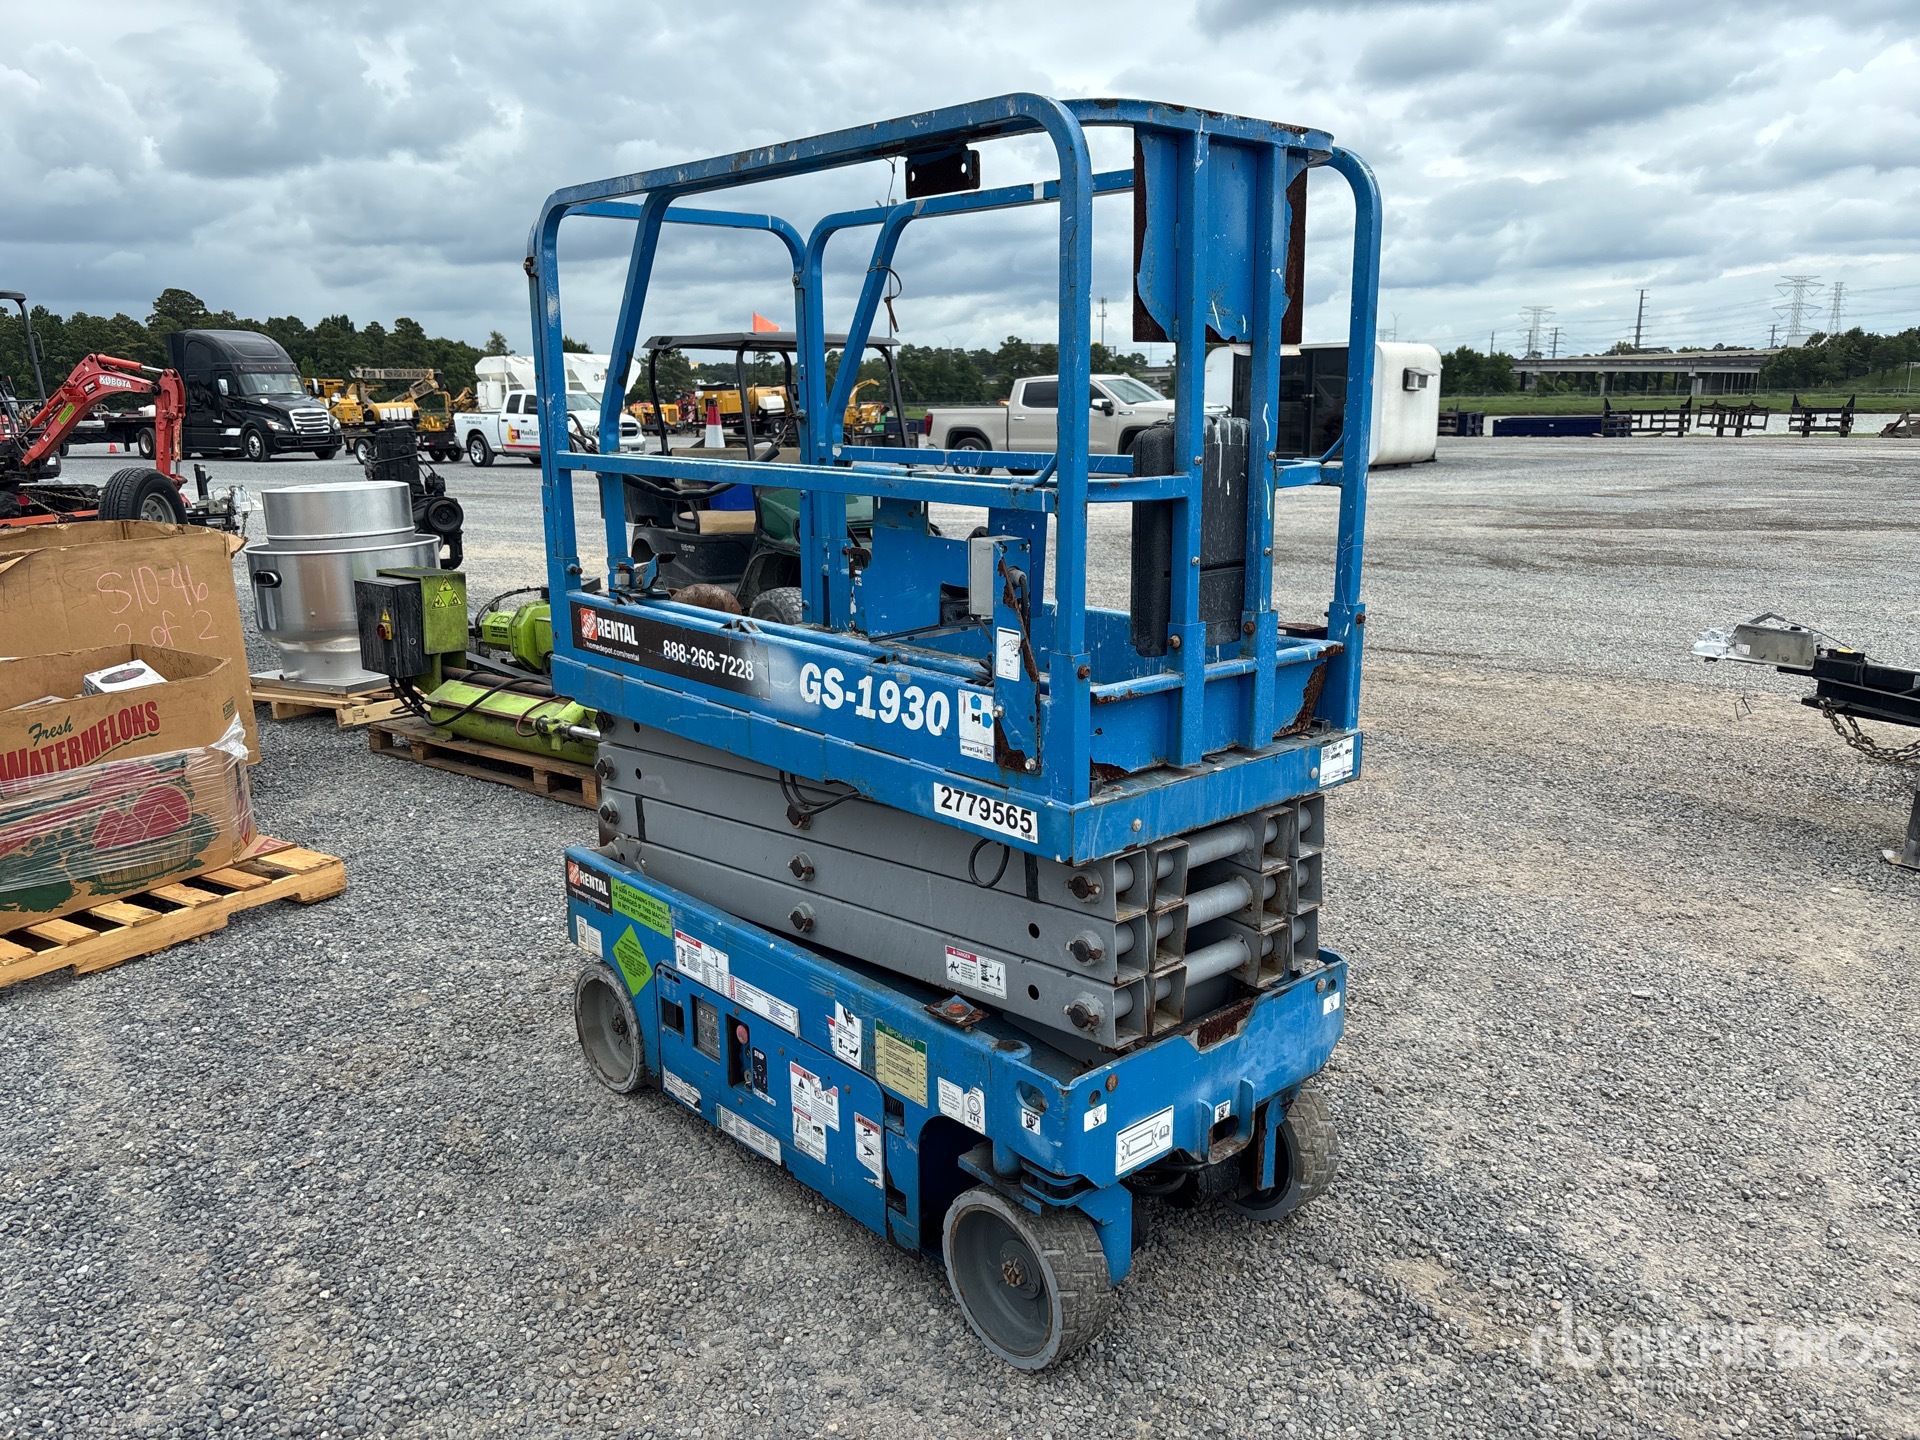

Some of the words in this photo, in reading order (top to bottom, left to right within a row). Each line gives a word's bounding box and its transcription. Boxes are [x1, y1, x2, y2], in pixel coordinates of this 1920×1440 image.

[99, 375, 132, 389] KUBOTA
[96, 561, 209, 614] S10-46
[151, 610, 181, 647] of
[192, 609, 220, 639] 2
[597, 617, 639, 646] RENTAL
[586, 641, 640, 662] homedepot.com/rental
[663, 639, 755, 681] 888-266-7228
[799, 662, 950, 737] GS-1930
[0, 700, 160, 793] WATERMELONS
[28, 715, 73, 747] Fresh
[940, 786, 1033, 834] 2779565
[579, 869, 609, 897] RENTAL
